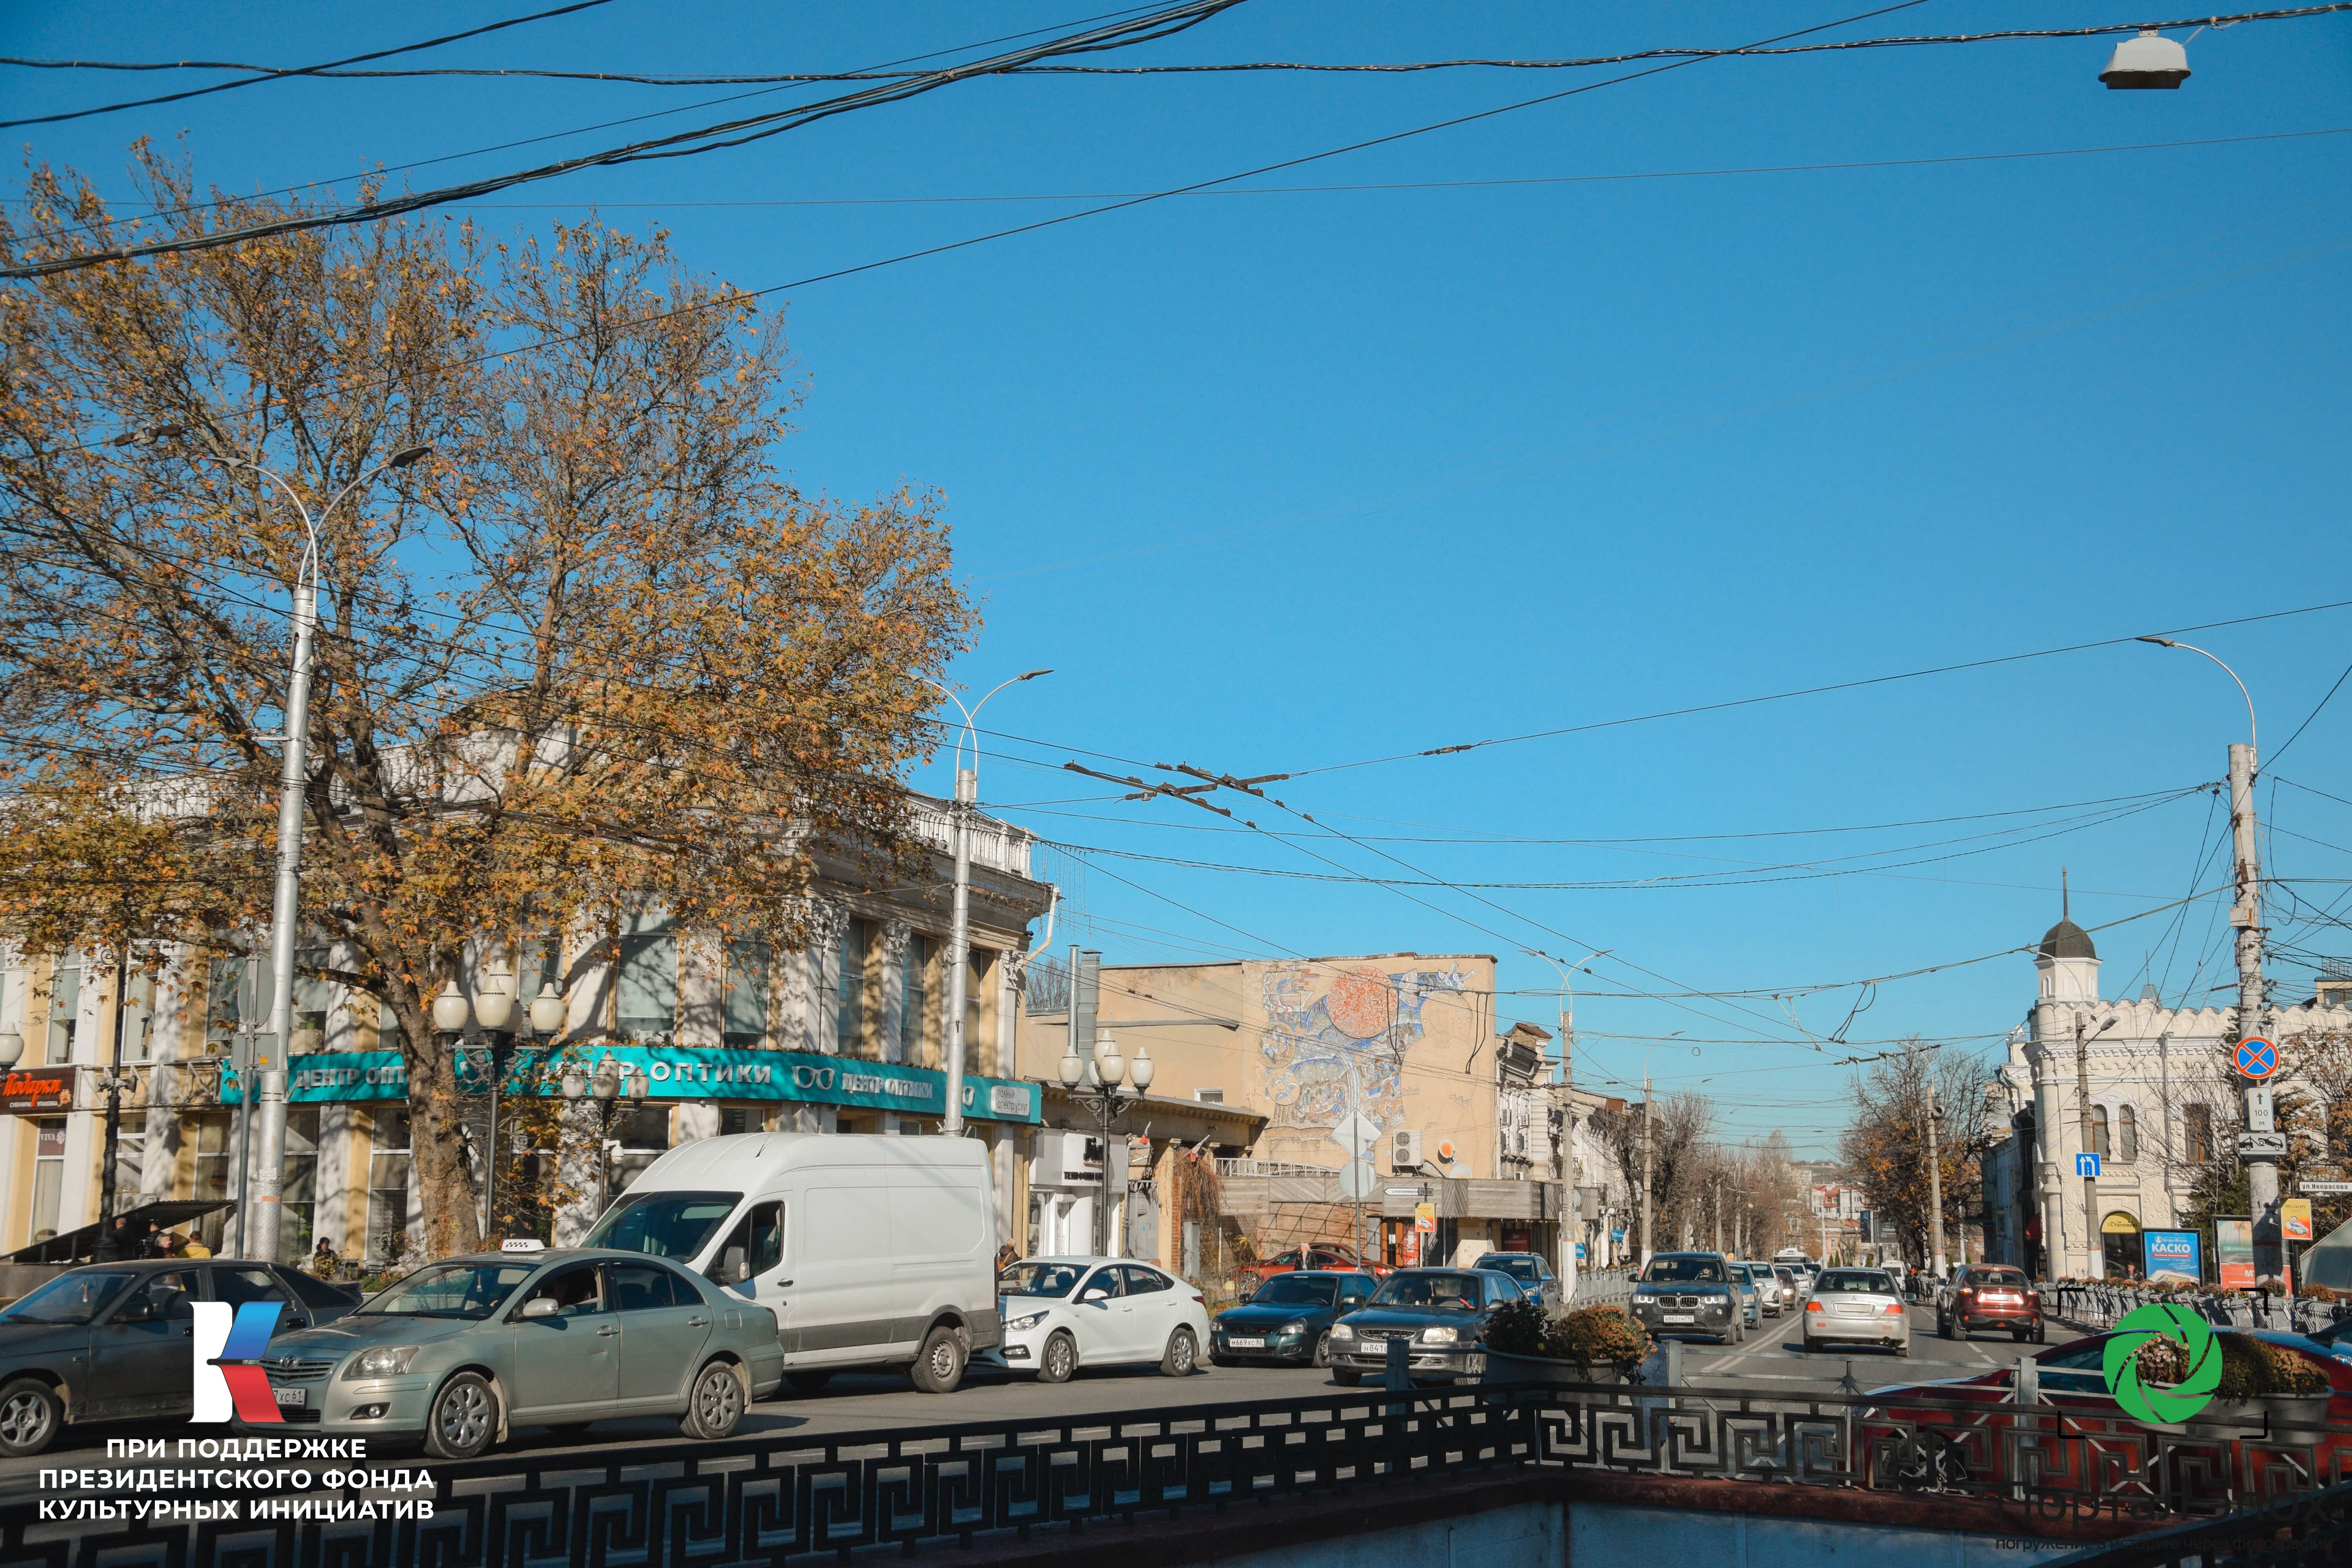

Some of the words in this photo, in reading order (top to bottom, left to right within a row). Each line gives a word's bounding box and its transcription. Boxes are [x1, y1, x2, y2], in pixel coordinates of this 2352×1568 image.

[296, 1068, 361, 1090] ЦЕНТР
[365, 1065, 406, 1085] ОПТ
[649, 1061, 771, 1084] ОПТИКИ
[2, 1072, 62, 1109] Подарки
[842, 1072, 884, 1094] ЦЕНТР
[884, 1077, 932, 1099] ОПТИКИ
[2151, 1243, 2191, 1253] КАСКО
[292, 1390, 302, 1400] 61
